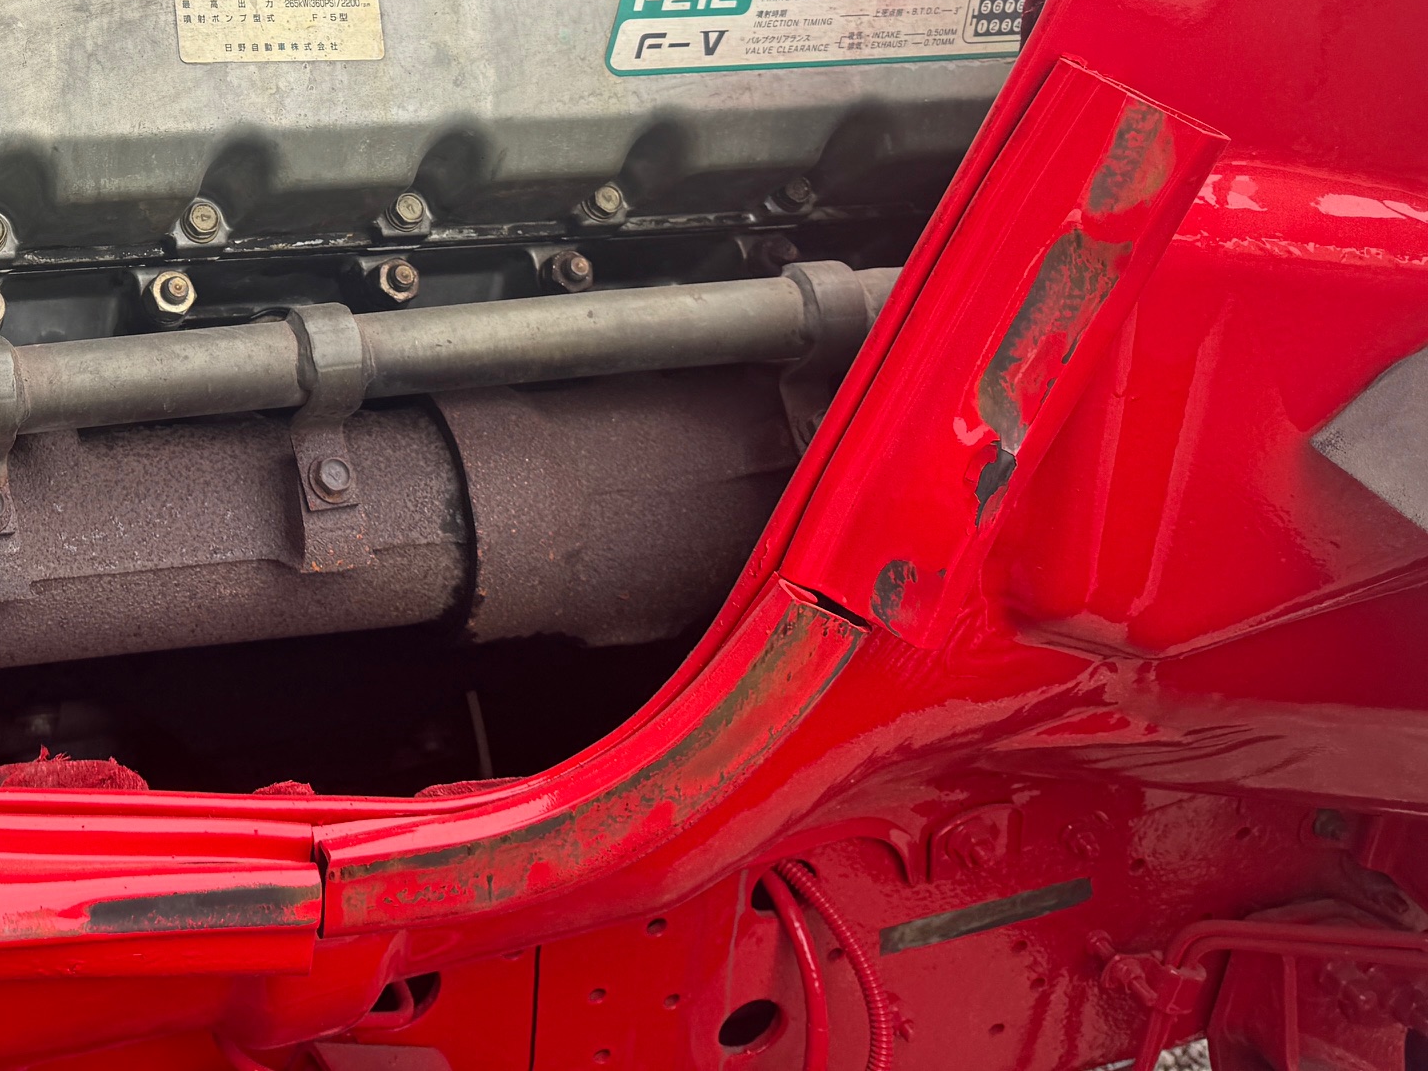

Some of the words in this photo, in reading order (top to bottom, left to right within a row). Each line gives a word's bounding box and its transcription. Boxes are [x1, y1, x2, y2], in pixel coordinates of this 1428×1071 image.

[753, 19, 800, 29] INJECTION
[802, 17, 833, 27] TIMING
[871, 30, 902, 39] INTAKE
[224, 41, 339, 53] 日野自動車株式会社
[744, 45, 774, 55] VALVE
[775, 43, 831, 54] CLEARANCE
[870, 39, 909, 49] EXHAUST
